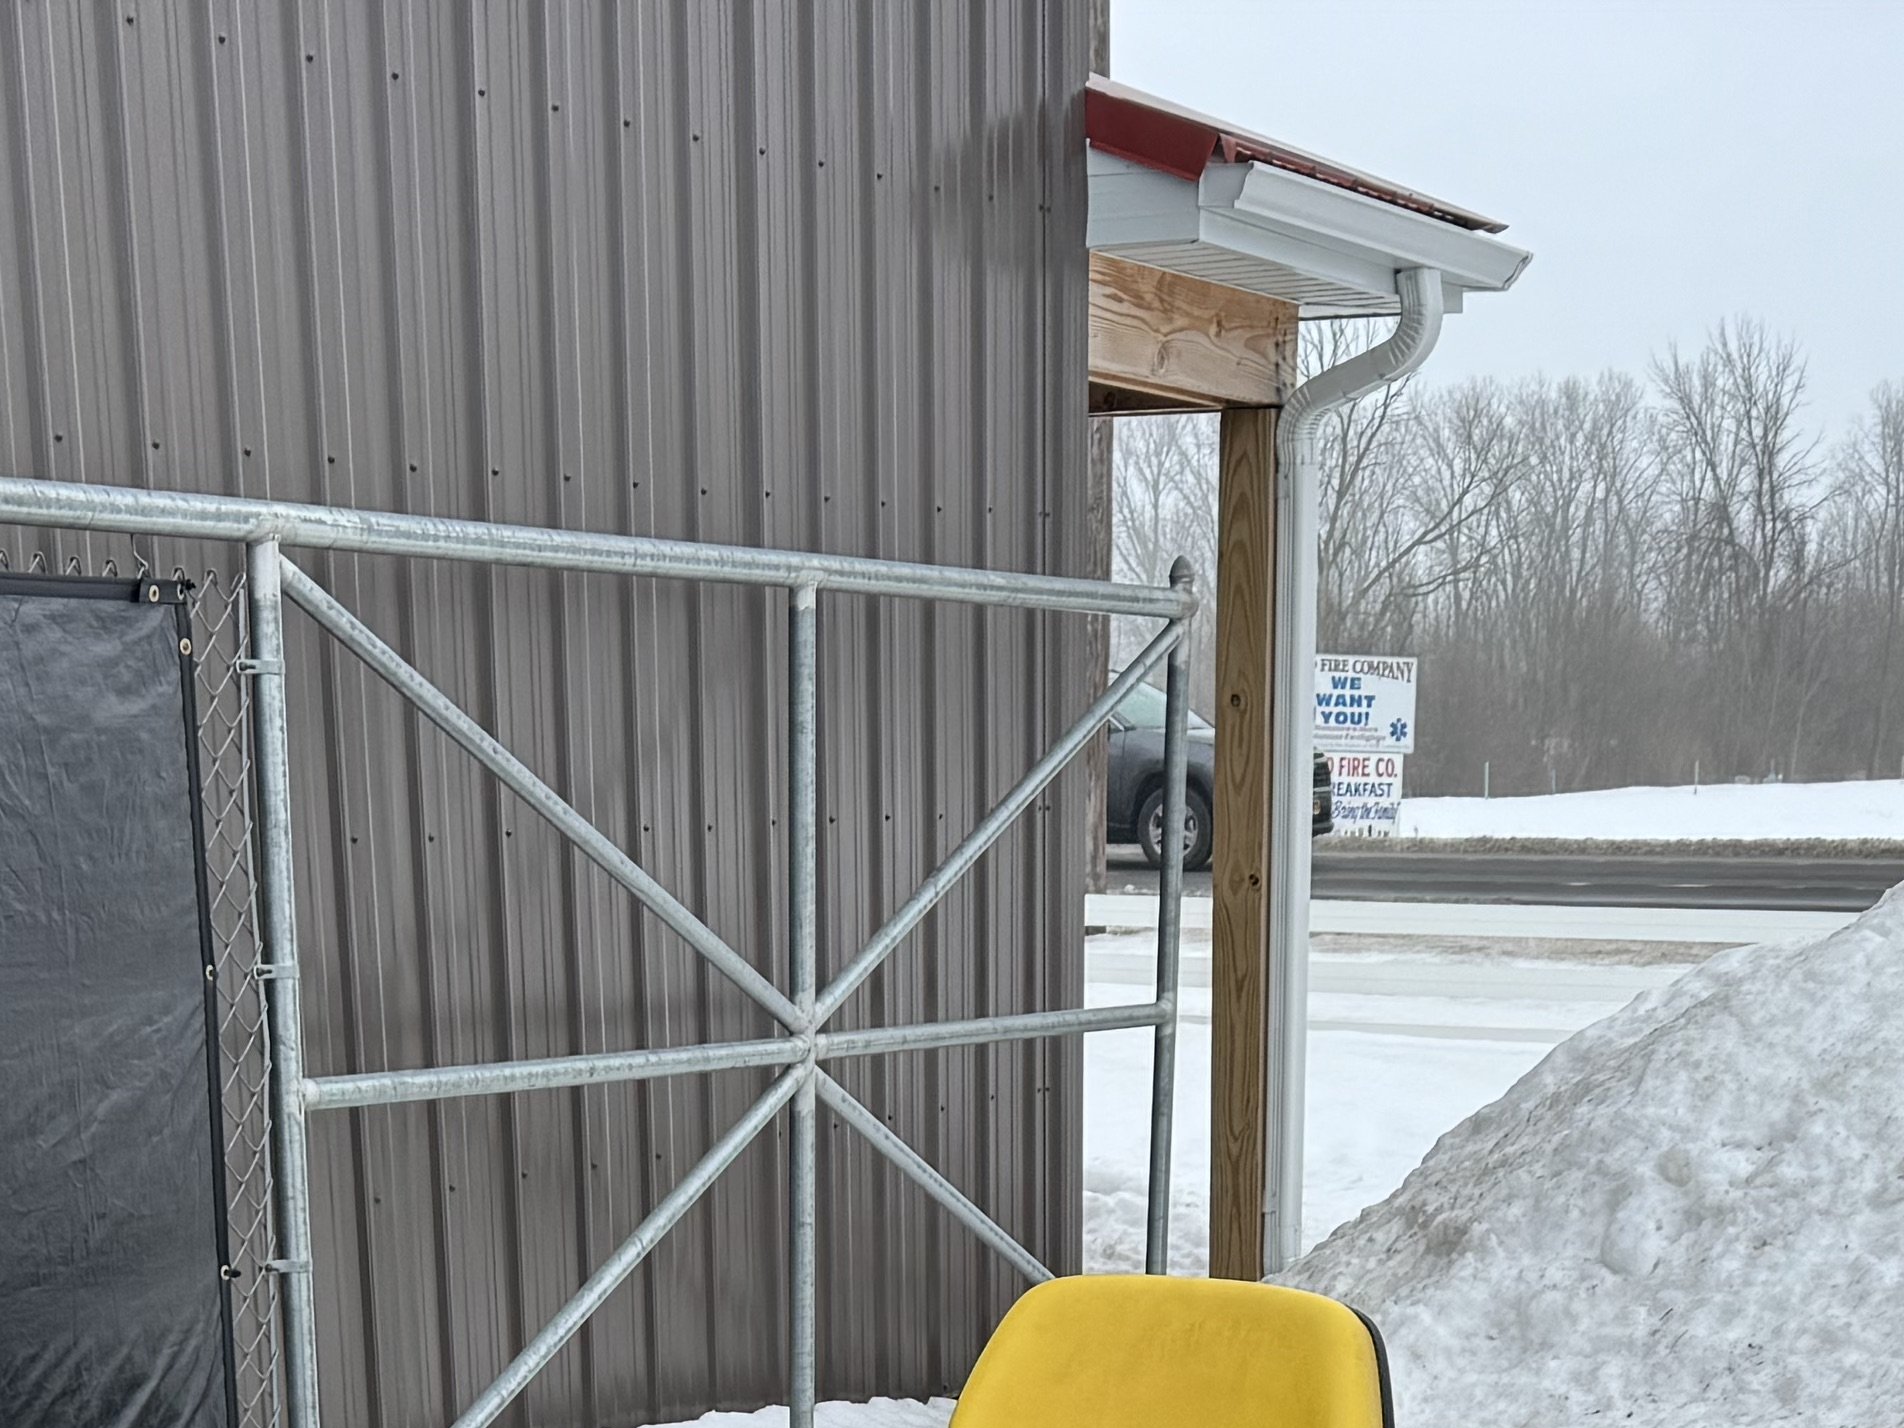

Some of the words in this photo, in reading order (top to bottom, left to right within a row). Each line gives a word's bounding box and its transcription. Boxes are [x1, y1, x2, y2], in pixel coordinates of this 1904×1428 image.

[1320, 658, 1349, 673] FIRE
[1352, 659, 1414, 684] COMPANY
[1331, 675, 1362, 690] WE
[1316, 693, 1376, 708] WANT
[1320, 711, 1370, 727] YOU!
[1338, 756, 1371, 777] FIRE
[1376, 757, 1398, 778] CO.
[1330, 781, 1393, 798] REAKFAST
